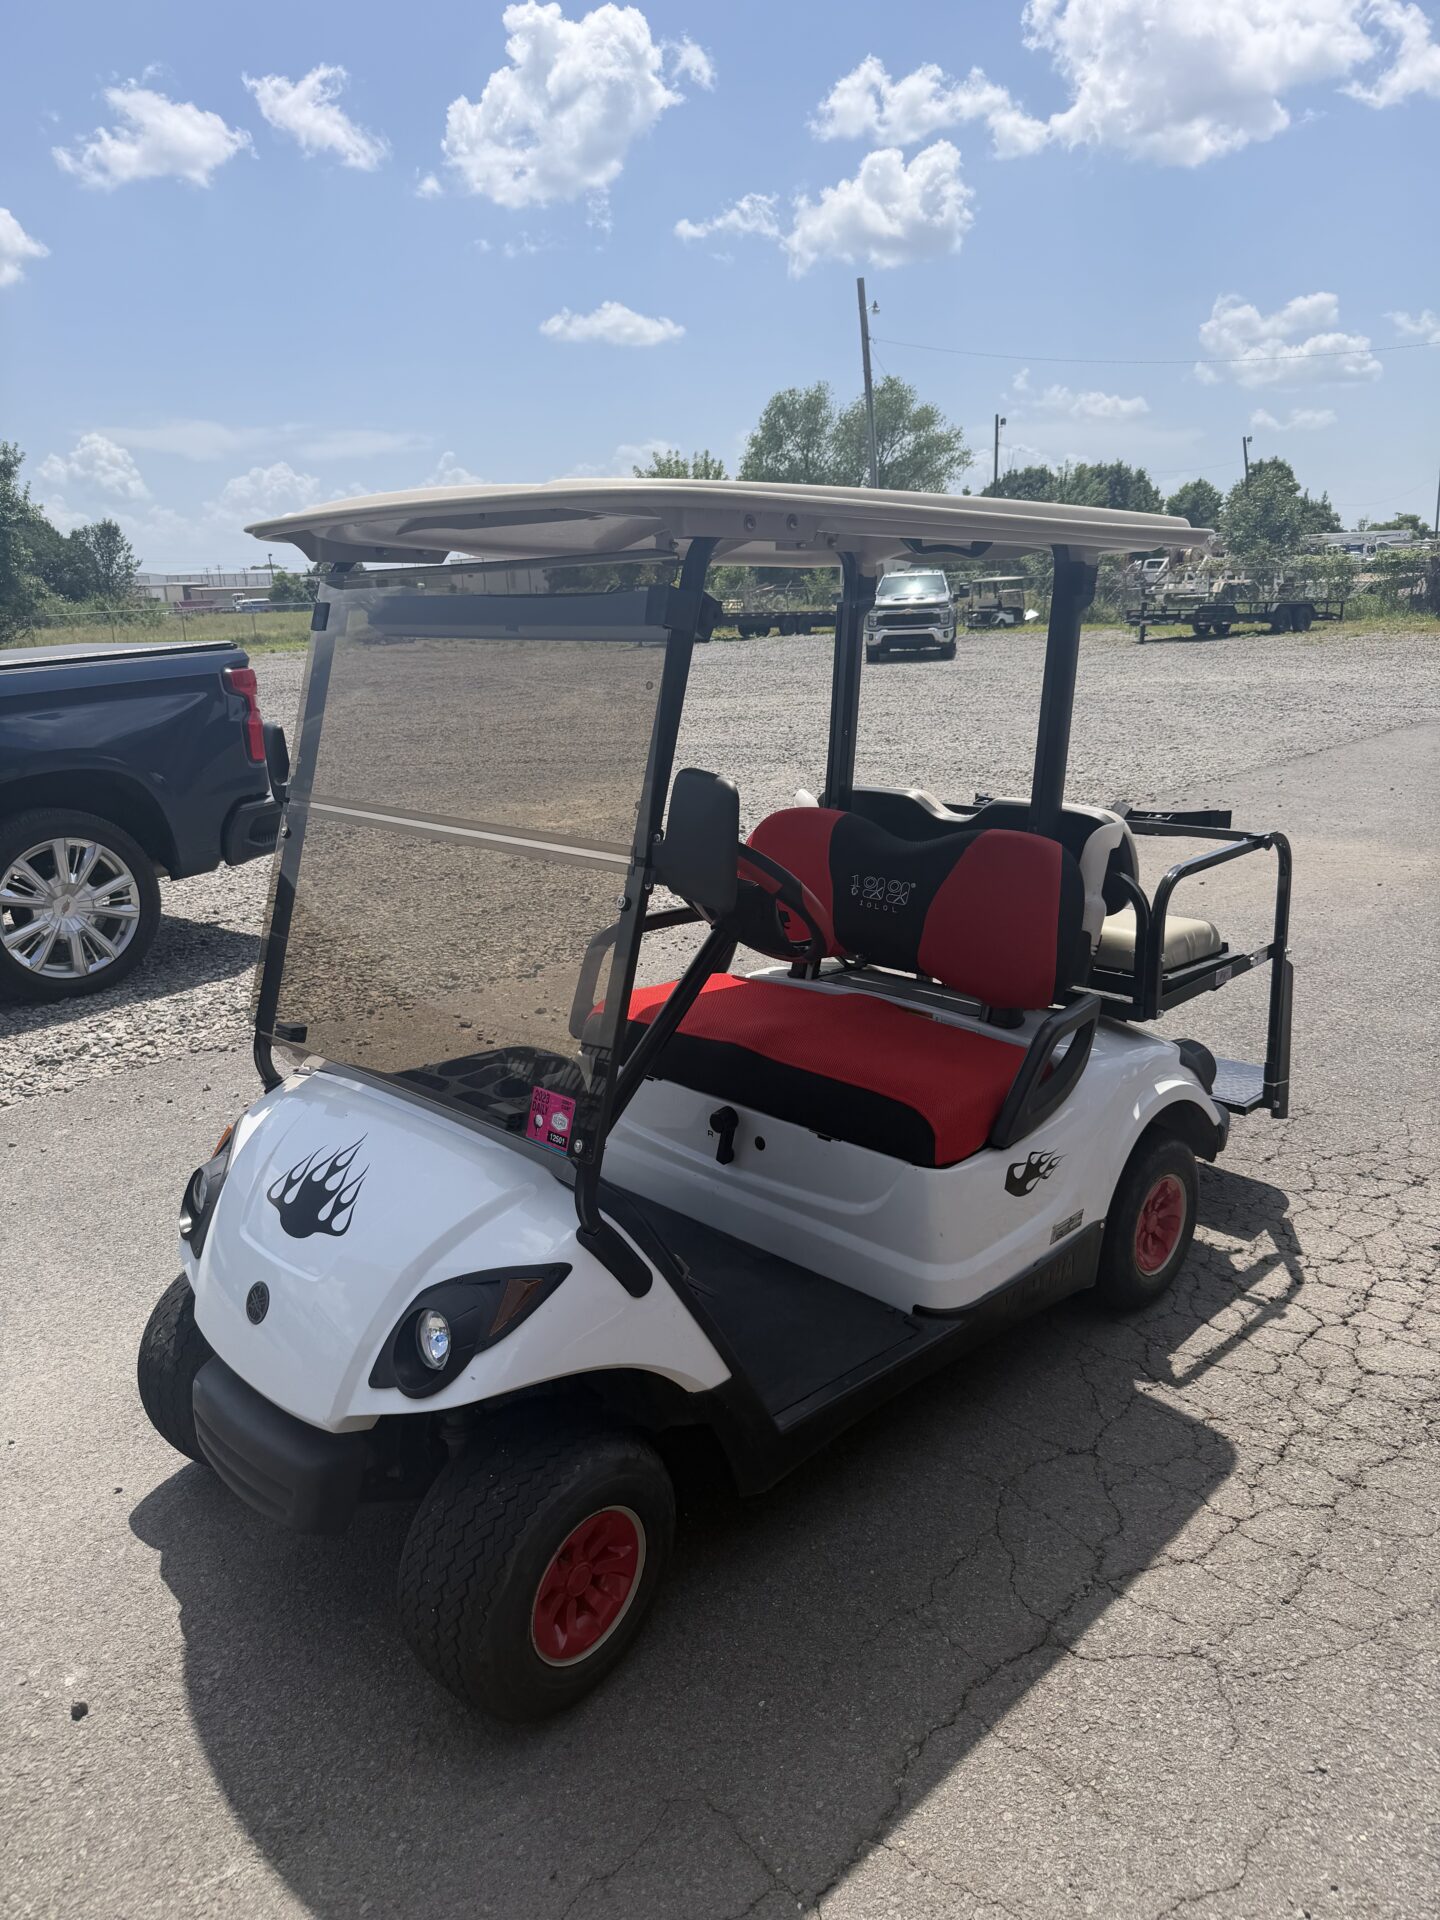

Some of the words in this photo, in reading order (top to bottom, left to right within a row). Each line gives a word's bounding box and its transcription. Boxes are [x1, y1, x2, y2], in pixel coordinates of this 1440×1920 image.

[534, 1089, 550, 1105] 2023
[532, 1101, 549, 1115] DAILY
[549, 1133, 565, 1145] 12501
[707, 1130, 714, 1138] R
